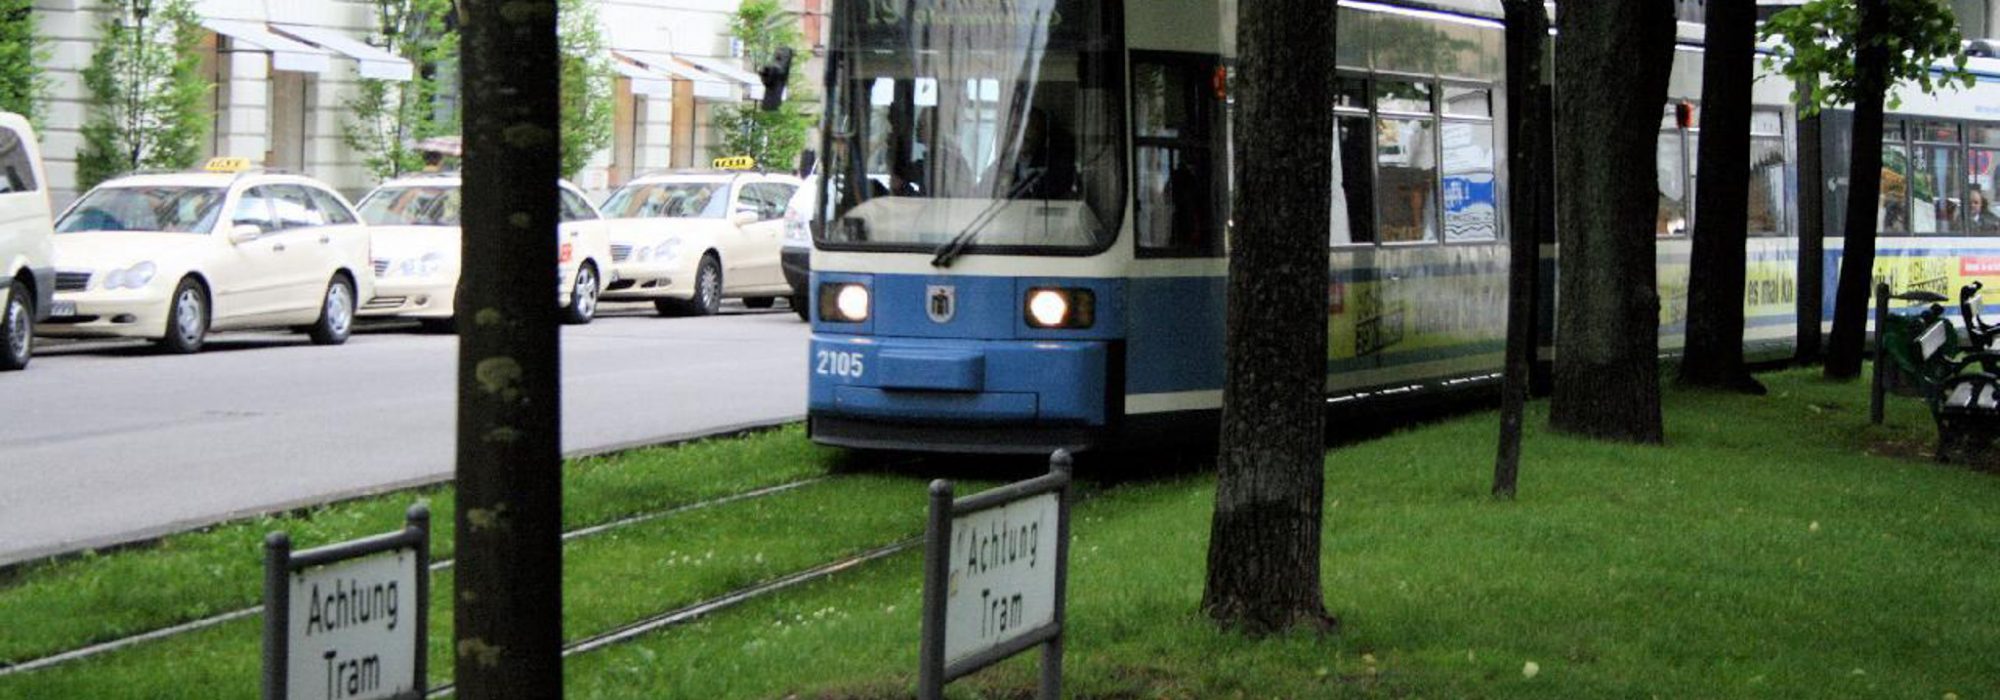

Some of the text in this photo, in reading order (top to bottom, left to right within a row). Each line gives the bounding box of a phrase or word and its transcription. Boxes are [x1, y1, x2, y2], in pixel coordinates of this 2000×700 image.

[817, 351, 863, 377] 2105
[968, 520, 1038, 575] Achtung
[307, 578, 399, 635] Achtung
[981, 589, 1022, 637] Tram
[323, 650, 380, 700] Tram
